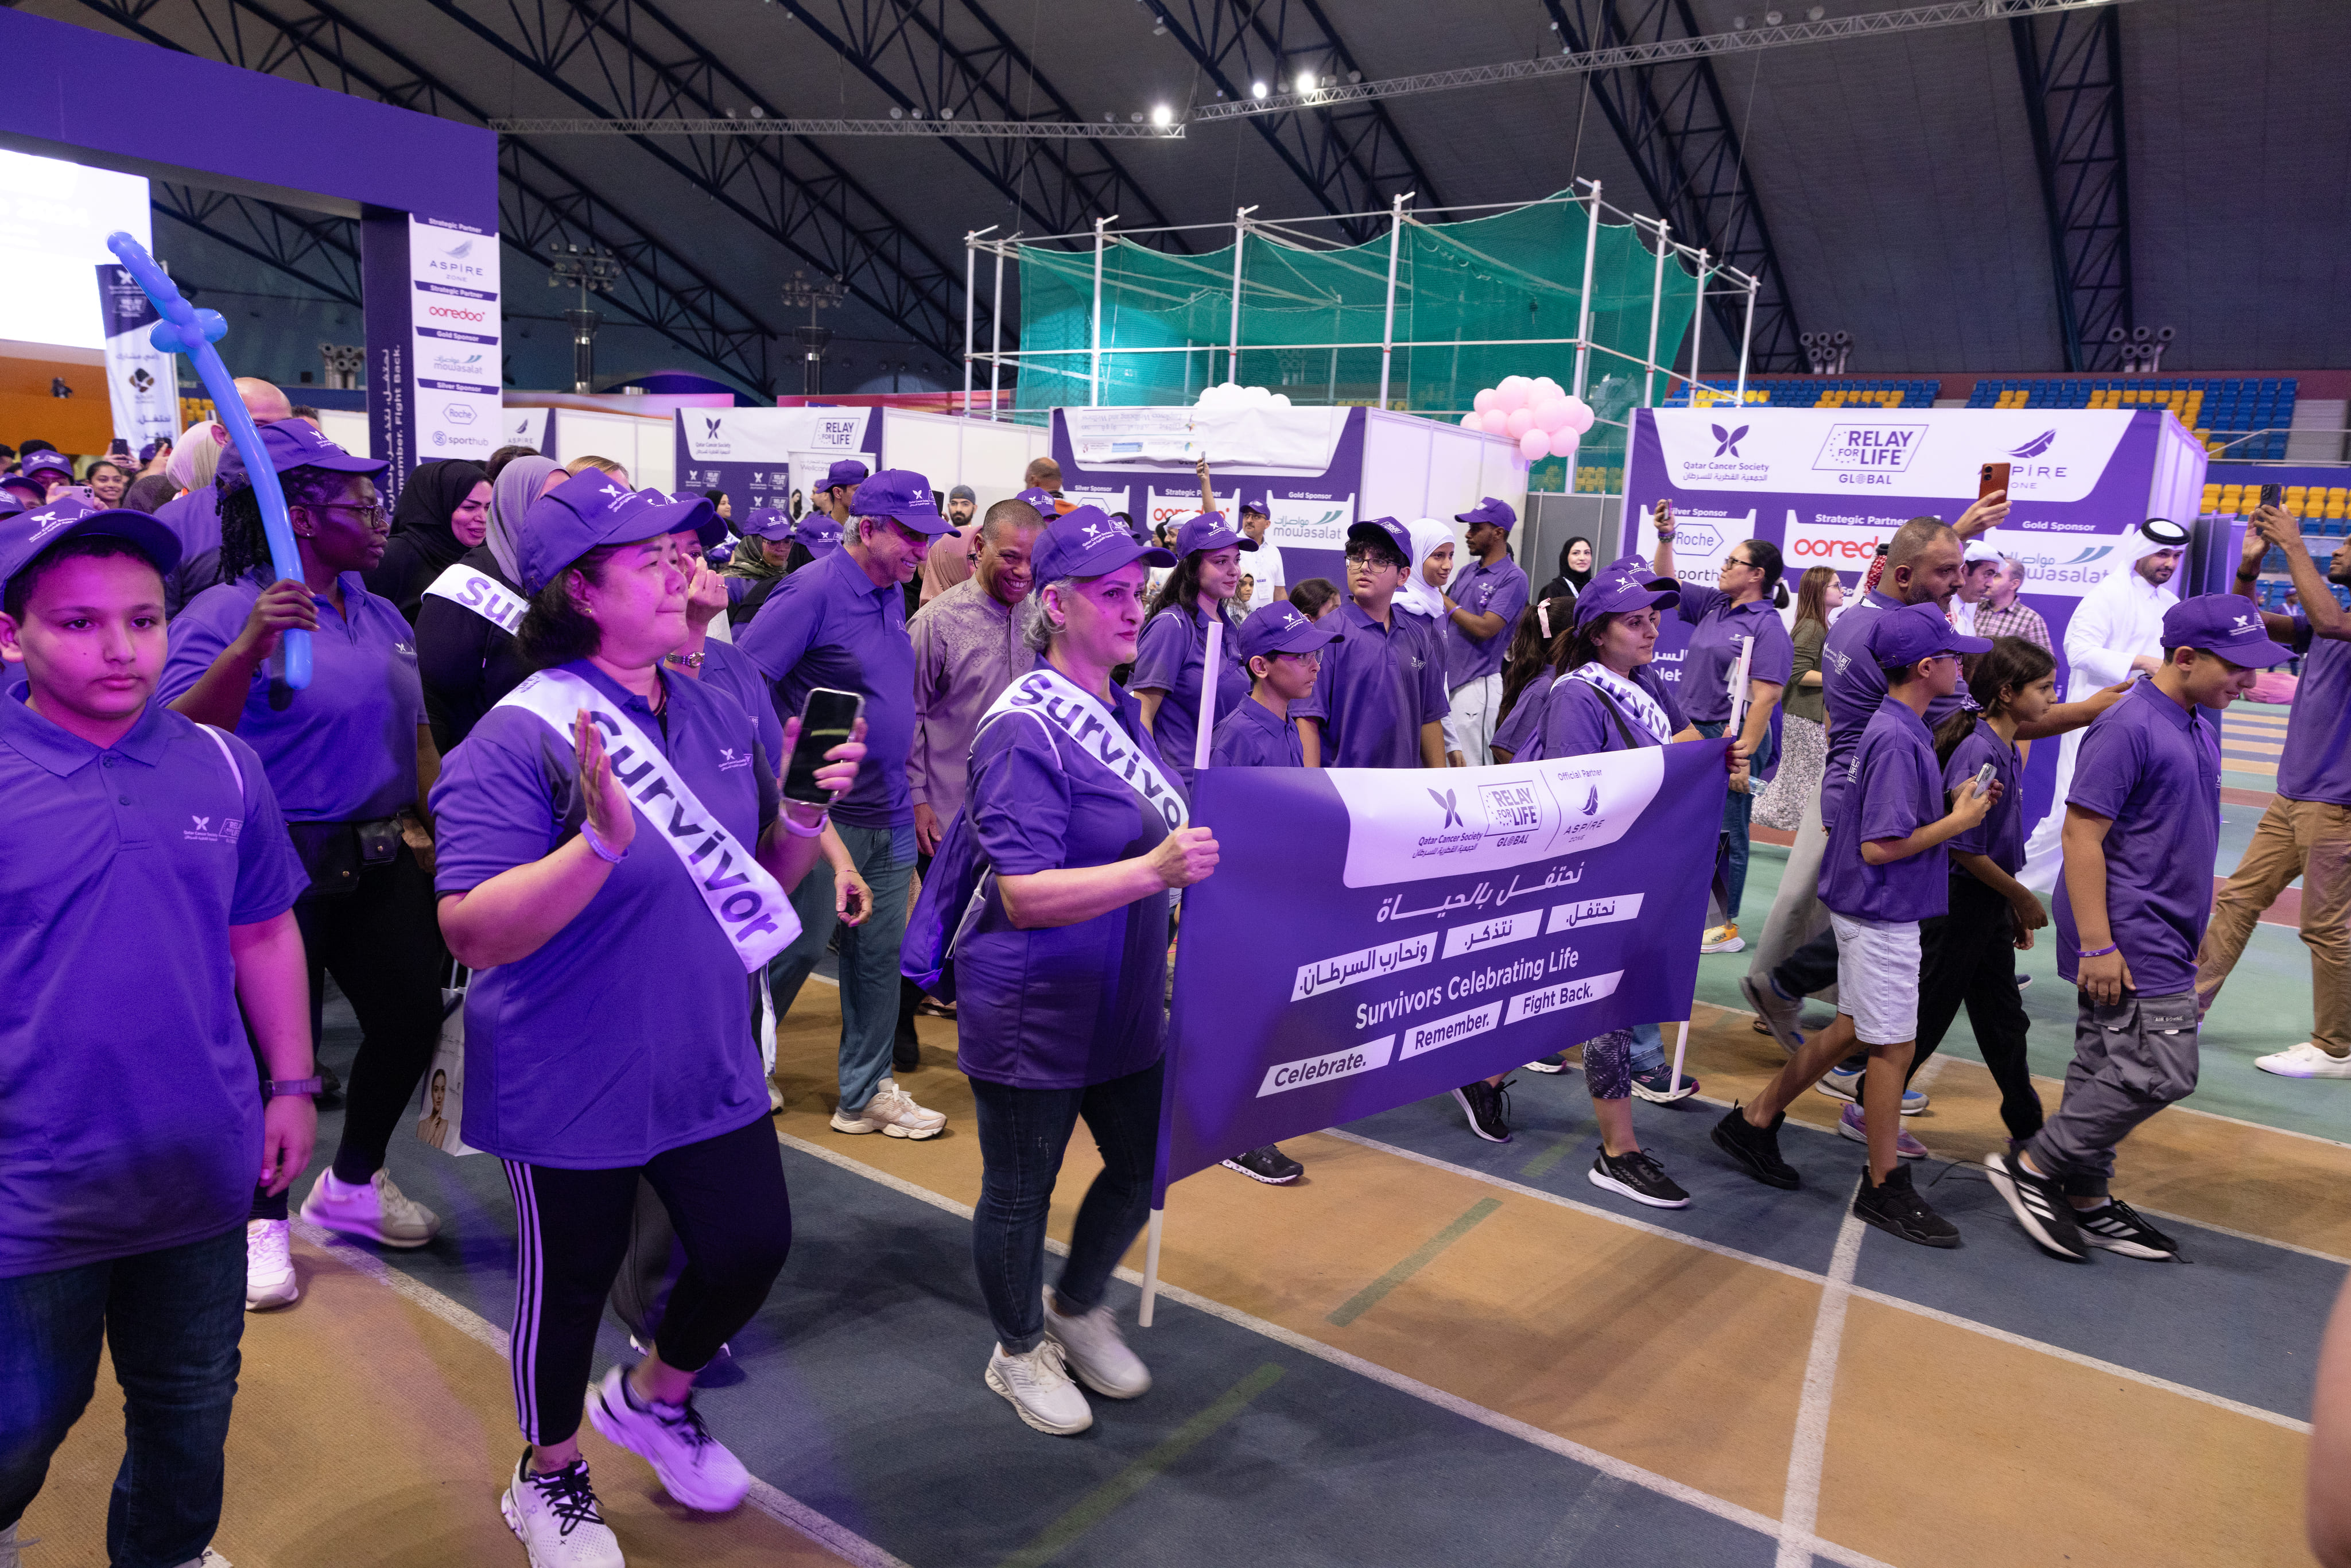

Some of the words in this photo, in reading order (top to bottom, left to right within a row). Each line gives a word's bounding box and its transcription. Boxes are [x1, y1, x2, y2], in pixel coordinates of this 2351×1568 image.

[429, 218, 458, 229] Strategic
[459, 222, 482, 234] Partner
[430, 285, 459, 296] Strategic
[460, 289, 484, 298] Partner
[429, 306, 485, 322] ooredoo
[436, 330, 455, 339] Gold
[455, 333, 479, 343] Sponsor
[433, 362, 483, 374] mowasalat
[436, 382, 455, 390] Silver
[456, 383, 482, 393] Sponsor
[394, 387, 403, 425] Fight
[449, 408, 472, 419] Roche
[826, 422, 854, 433] RELAY
[448, 435, 489, 447] sporthub
[832, 434, 849, 445] LIFE
[1848, 430, 1914, 447] RELAY
[1838, 448, 1860, 457] FOR
[1860, 449, 1903, 465] LIFE
[1683, 461, 1707, 469] Qatar
[1709, 462, 1737, 470] Cancer
[1739, 463, 1770, 472] Society
[1165, 488, 1196, 497] Strategic
[1692, 509, 1728, 517] Sponsor
[1815, 514, 1865, 525] Strategic
[2022, 521, 2048, 529] Gold
[2050, 522, 2096, 531] Sponsor
[1273, 526, 1341, 540] mowasalat
[1675, 531, 1714, 546] Roche
[1794, 535, 1879, 559] oored
[1010, 674, 1181, 831] Survivo
[1557, 769, 1581, 781] Official
[1581, 768, 1603, 779] Partner
[1491, 786, 1535, 807] RELAY
[1496, 809, 1512, 820] FOR
[1512, 806, 1538, 827] LIFE
[1564, 818, 1607, 836] ASPIRE
[1418, 835, 1437, 847] Qatar
[1437, 833, 1460, 845] Cancer
[1461, 830, 1484, 844] Society
[1568, 834, 1586, 843] ZONE
[1355, 984, 1442, 1030] Survivors
[1446, 954, 1544, 1002] Celebrating
[1547, 946, 1580, 975] Life
[1274, 1053, 1367, 1088] Celebrate.
[1415, 1012, 1490, 1051] Remember.
[1522, 992, 1557, 1016] Fight
[1559, 981, 1594, 1006] Back.
